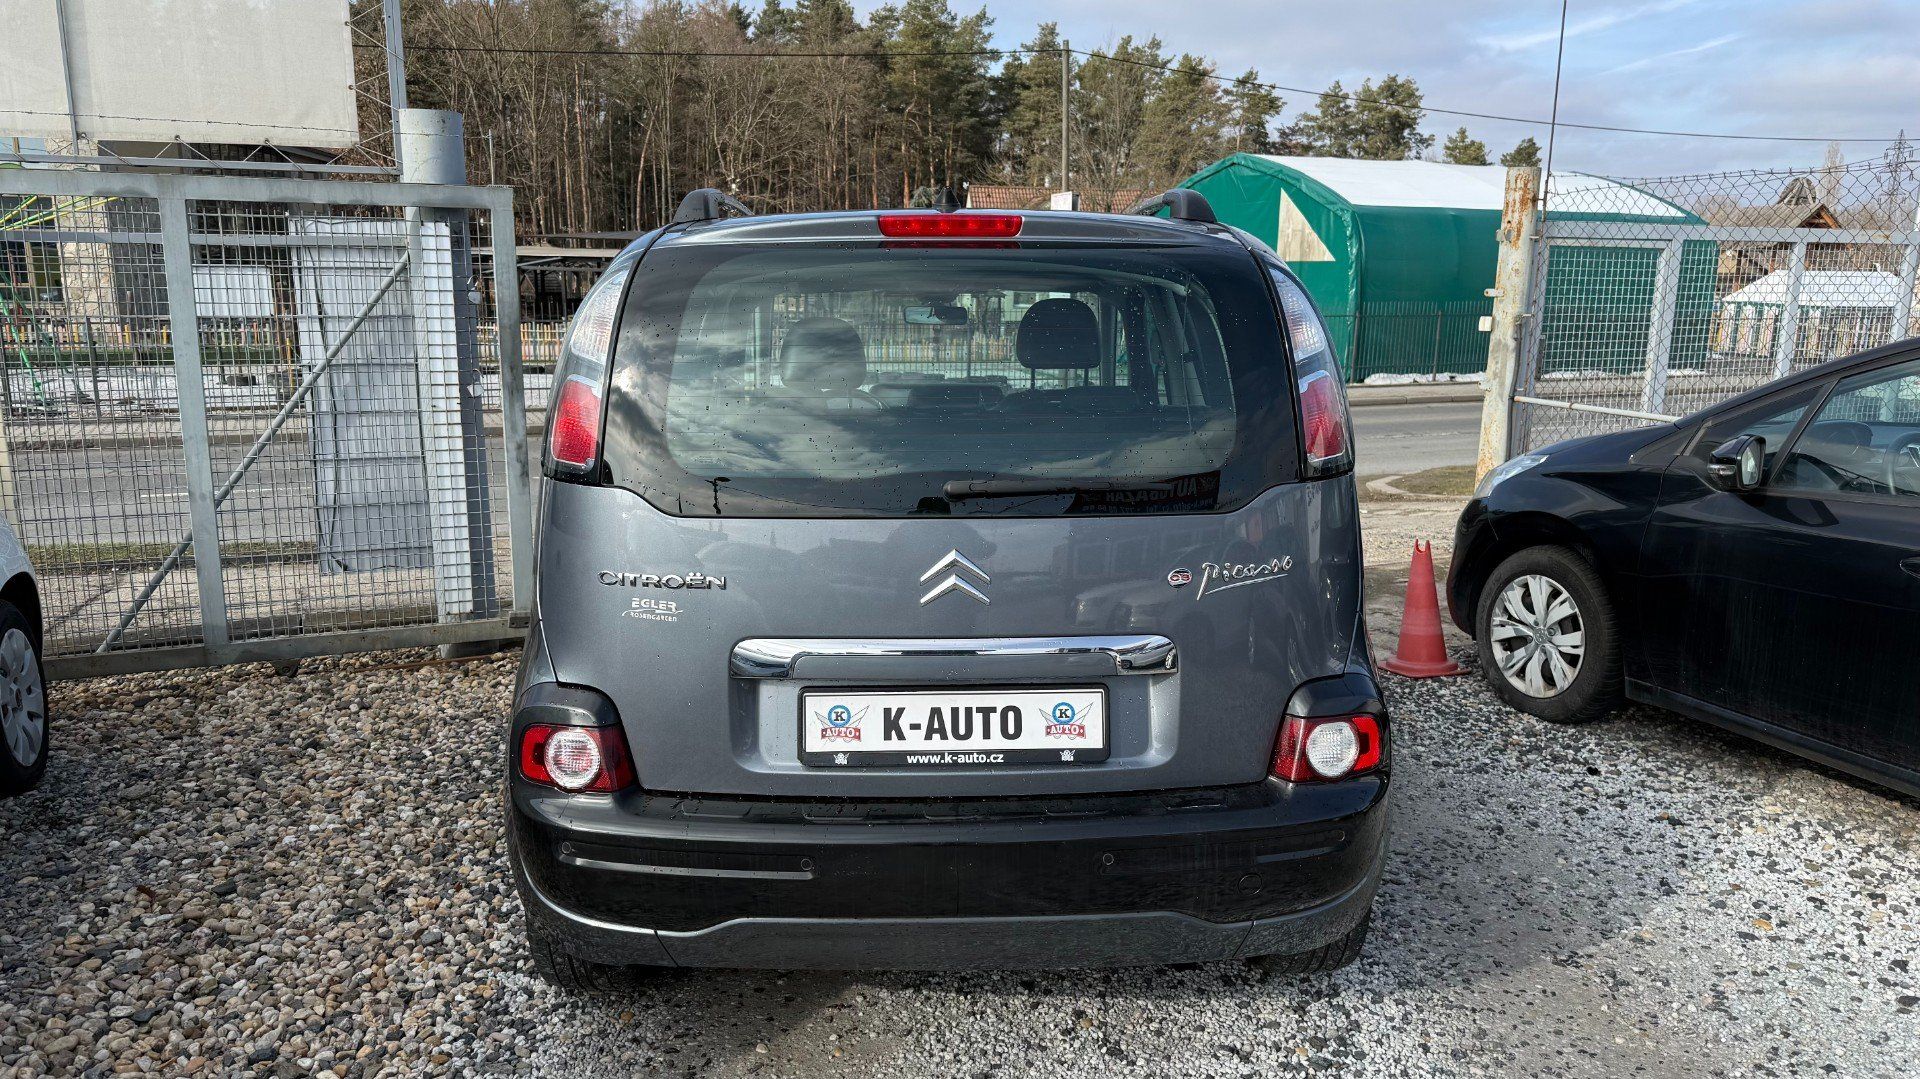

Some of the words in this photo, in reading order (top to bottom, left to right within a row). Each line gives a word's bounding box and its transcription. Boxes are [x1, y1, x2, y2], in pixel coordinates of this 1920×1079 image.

[598, 571, 727, 590] CITROËN
[1197, 555, 1293, 601] Picasso
[631, 598, 677, 612] EGLER
[834, 711, 846, 722] K
[1058, 708, 1070, 719] K
[883, 705, 1023, 741] K-AUTO
[1050, 723, 1080, 735] AUTO
[825, 727, 855, 737] AUTO
[907, 752, 1004, 764] www.k-auto.cz
